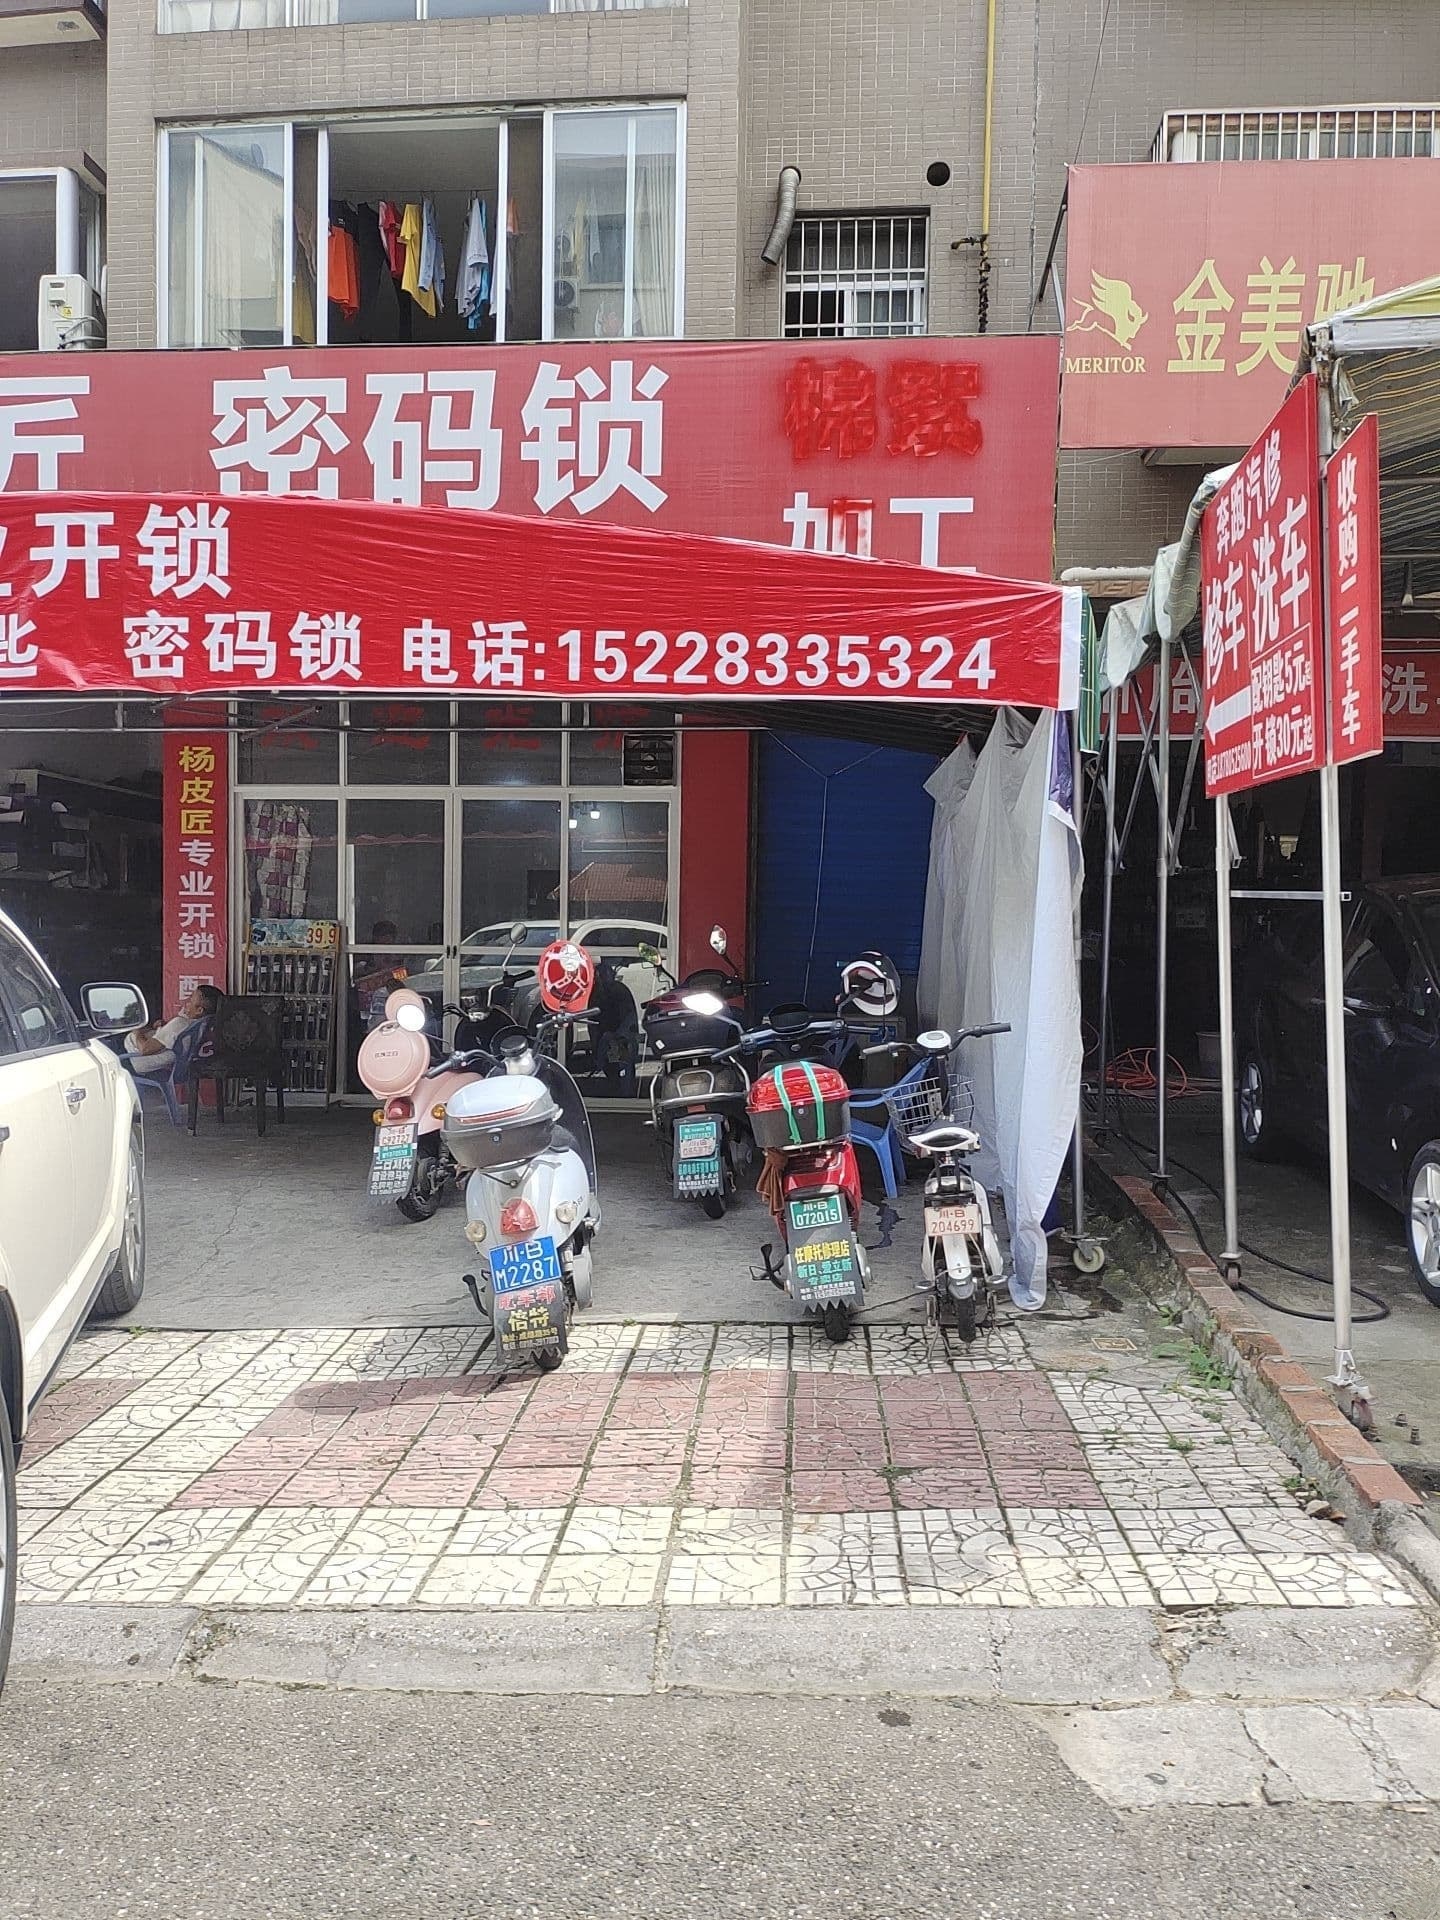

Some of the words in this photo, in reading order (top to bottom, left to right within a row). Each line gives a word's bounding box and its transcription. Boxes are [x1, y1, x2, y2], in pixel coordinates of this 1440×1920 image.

[1065, 357, 1146, 374] MERITOR
[209, 360, 669, 515] 密码锁
[783, 491, 977, 572] 加工
[1216, 429, 1281, 563] 奔跑汽修
[0, 502, 230, 599] 开锁
[1203, 560, 1246, 690] 修车
[1251, 494, 1310, 655] 洗车
[1337, 452, 1361, 745] 收购二手车
[123, 609, 363, 681] 密码锁
[402, 619, 996, 690] 电话:15228335324
[1382, 662, 1440, 714] 洗
[178, 745, 215, 960] 杨皮匠专业开锁
[796, 1208, 838, 1226] 072015
[931, 1218, 975, 1234] 204699
[495, 1256, 555, 1290] M2287
